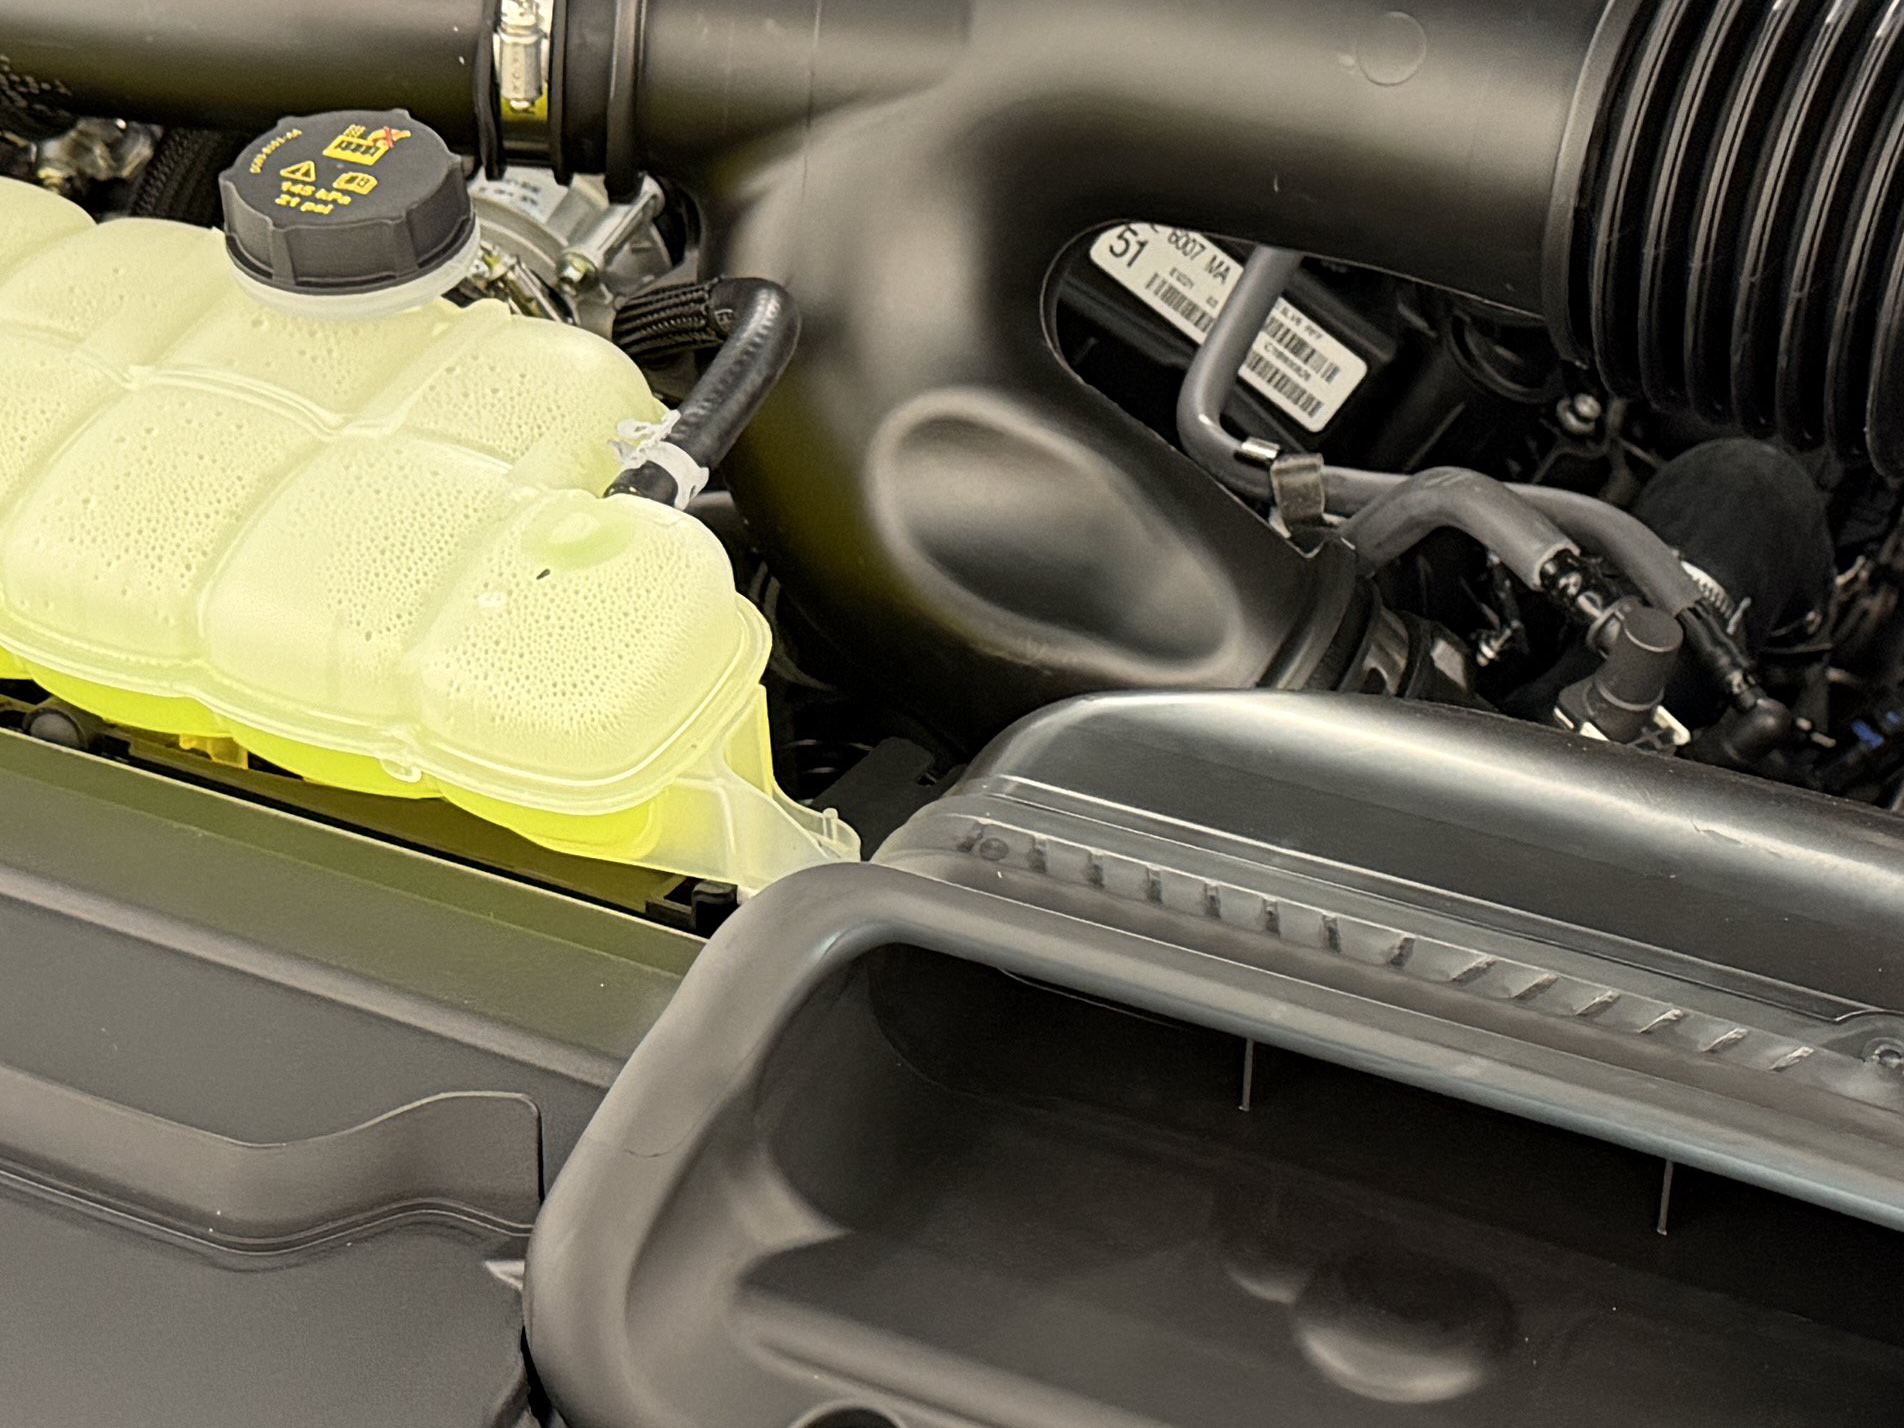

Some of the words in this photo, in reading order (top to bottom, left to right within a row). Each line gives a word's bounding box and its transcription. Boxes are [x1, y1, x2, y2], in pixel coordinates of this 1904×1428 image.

[315, 188, 352, 205] kPa
[299, 201, 335, 215] psi
[1108, 223, 1149, 268] 51
